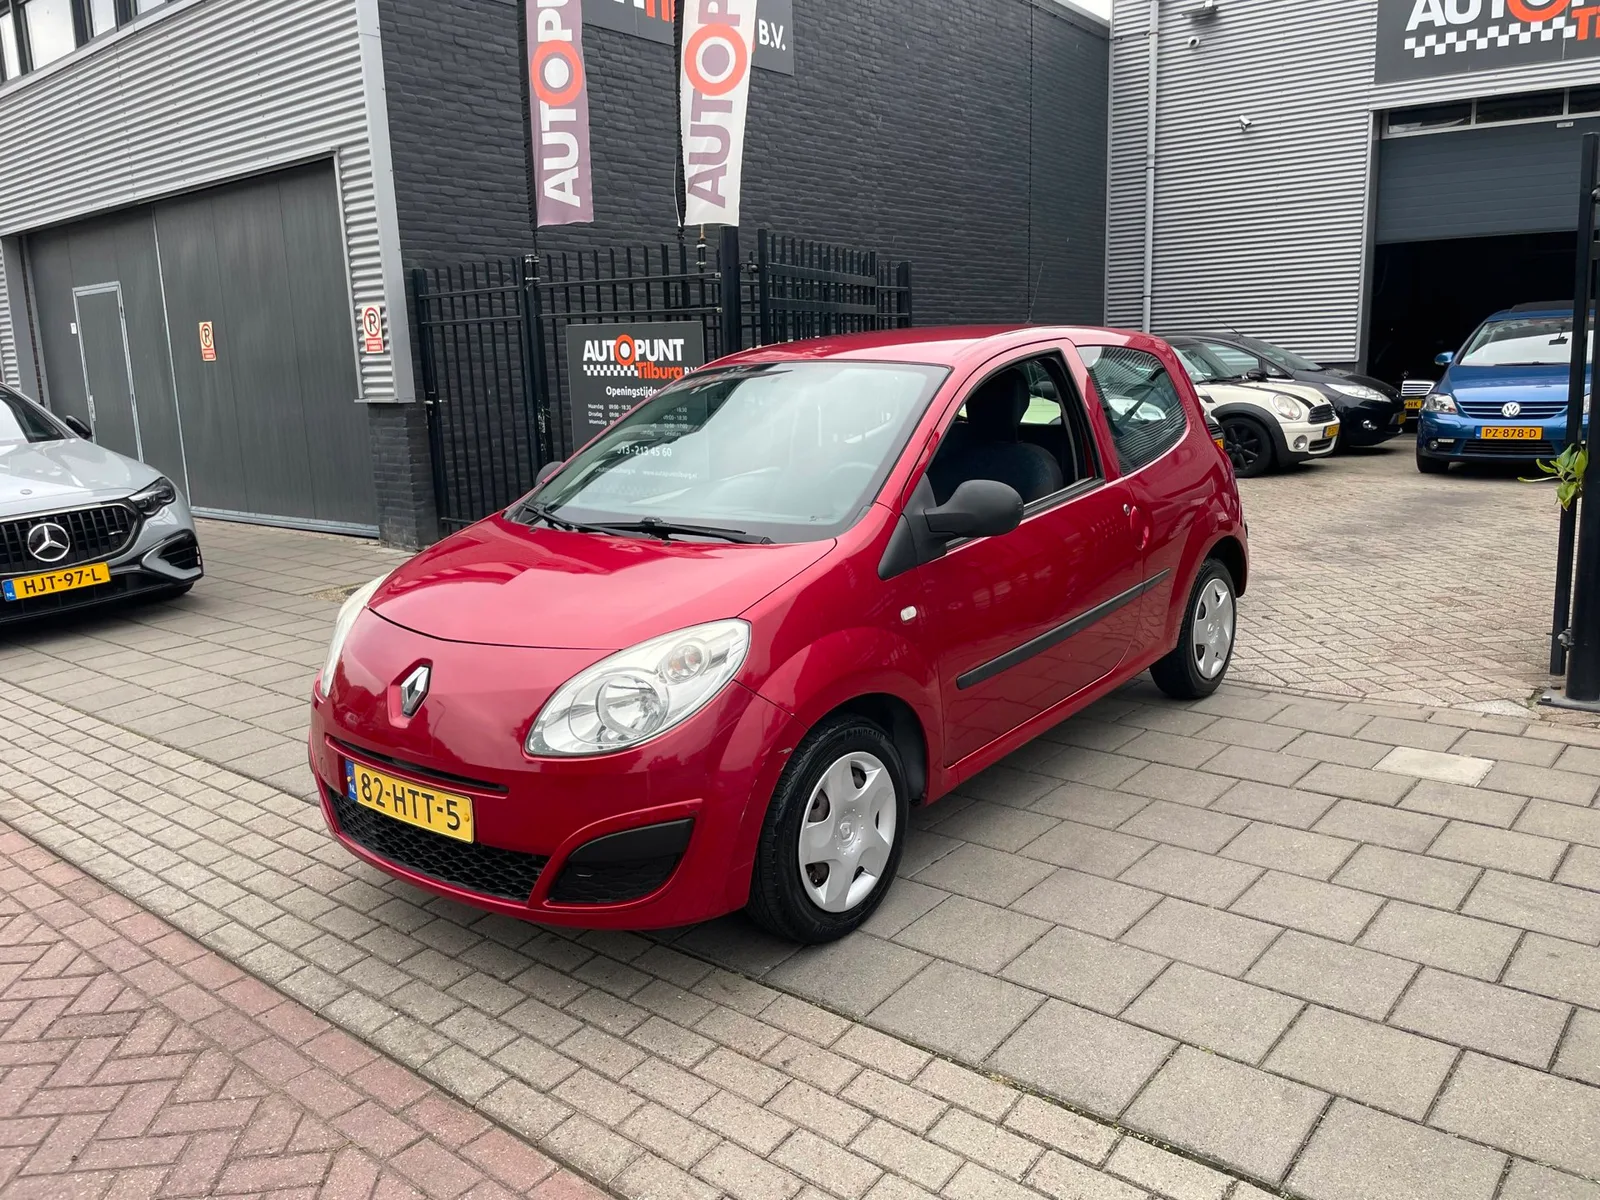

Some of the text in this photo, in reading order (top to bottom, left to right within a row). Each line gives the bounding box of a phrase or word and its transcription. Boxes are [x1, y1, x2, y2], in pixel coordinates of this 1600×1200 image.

[758, 18, 787, 51] B.V.
[532, 0, 583, 208] AUTOP
[582, 334, 685, 366] AUTOPUNT
[1485, 428, 1537, 438] PZ-878-D
[23, 567, 102, 594] HJT-97-L
[360, 773, 461, 831] 82-HTT-5
